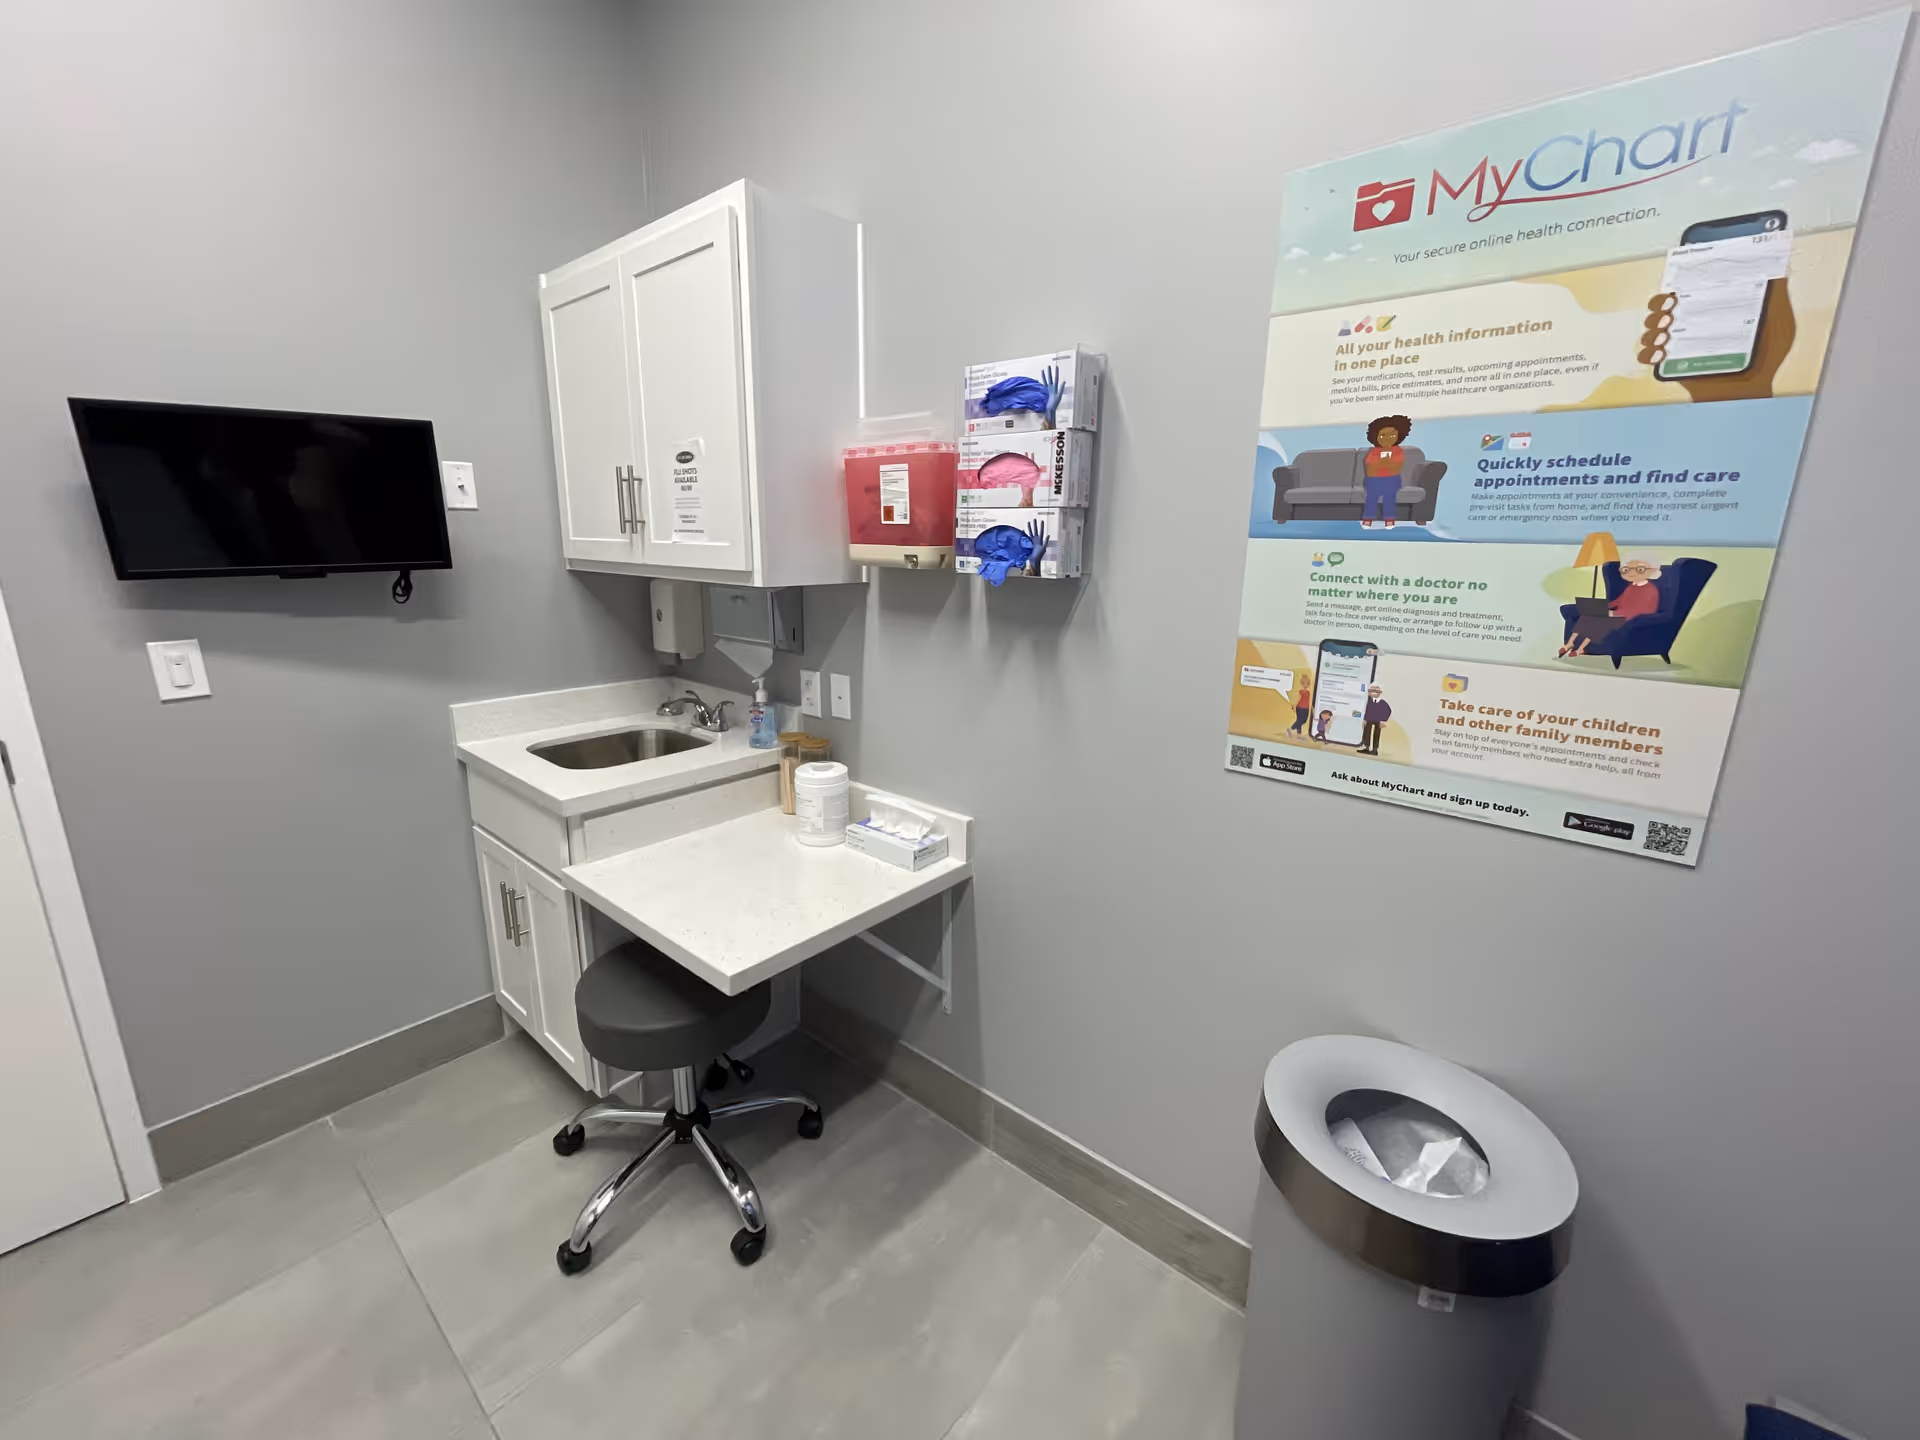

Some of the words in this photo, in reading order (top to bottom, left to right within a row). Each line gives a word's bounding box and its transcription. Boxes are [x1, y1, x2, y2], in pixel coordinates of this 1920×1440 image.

[1427, 99, 1748, 223] MyChart
[1393, 250, 1421, 264] Your
[1424, 244, 1466, 258] secure
[1469, 233, 1513, 251] online
[1516, 222, 1563, 241] health
[1566, 206, 1660, 232] connection.
[1336, 343, 1354, 355] All
[1357, 341, 1391, 355] your
[1394, 332, 1444, 349] health
[1448, 320, 1553, 342] information
[1334, 360, 1347, 371] in
[1351, 359, 1376, 369] one
[1380, 354, 1420, 369] place
[1346, 376, 1363, 384] your
[1365, 371, 1416, 381] medications,
[1418, 369, 1433, 377] test
[1434, 366, 1465, 375] results,
[1468, 361, 1512, 373] upcoming
[1515, 353, 1586, 368] appointments,
[1331, 385, 1360, 395] medical
[1361, 384, 1379, 392] bills,
[1381, 382, 1400, 391] price
[1402, 379, 1443, 389] estimates,
[1446, 376, 1463, 384] and
[1464, 375, 1487, 383] more
[1490, 372, 1501, 380] all
[1503, 371, 1511, 379] in
[1533, 368, 1562, 378] place,
[1565, 365, 1589, 374] even
[1592, 362, 1600, 371] if
[1330, 395, 1354, 406] you've
[1405, 389, 1439, 400] multiple
[1441, 386, 1487, 395] healthcare
[1489, 380, 1554, 392] organizations.
[1477, 457, 1542, 472] Quickly
[1546, 453, 1632, 468] schedule
[1474, 474, 1599, 489] appointments
[1604, 471, 1641, 484] and
[1646, 469, 1689, 483] find
[1693, 471, 1741, 482] care
[1469, 503, 1505, 511] pre-visit
[1558, 502, 1588, 511] home,
[1590, 502, 1610, 510] and
[1613, 502, 1633, 510] find
[1636, 502, 1653, 510] the
[1656, 502, 1698, 510] nearest
[1701, 501, 1739, 511] urgent
[1496, 492, 1561, 502] appointments
[1575, 492, 1598, 500] your
[1600, 490, 1671, 499] convenience,
[1673, 489, 1727, 499] complete
[1499, 514, 1550, 523] emergency
[1611, 514, 1629, 522] you
[1632, 513, 1659, 521] need
[1662, 513, 1672, 521] it.
[1310, 572, 1364, 584] Connect
[1367, 574, 1399, 586] with
[1402, 578, 1411, 587] a
[1414, 576, 1465, 590] doctor
[1467, 581, 1488, 591] no
[1308, 588, 1353, 598] matter
[1356, 589, 1399, 601] where
[1402, 593, 1429, 604] you
[1433, 595, 1458, 605] are
[1319, 610, 1360, 619] face-to-face
[1378, 615, 1401, 623] video,
[1413, 619, 1443, 627] arrange
[1455, 620, 1481, 629] follow
[1496, 624, 1515, 632] with
[1331, 603, 1363, 612] message,
[1378, 606, 1402, 614] online
[1402, 607, 1440, 617] diagnosis
[1442, 610, 1457, 618] and
[1459, 611, 1504, 621] treatment,
[1336, 621, 1362, 629] person,
[1364, 623, 1403, 633] depending
[1417, 627, 1429, 635] the
[1431, 629, 1450, 637] level
[1481, 633, 1497, 641] you
[1440, 699, 1474, 712] Take
[1479, 705, 1512, 718] care
[1516, 709, 1535, 721] of
[1537, 713, 1579, 726] your
[1582, 718, 1660, 738] children
[1437, 715, 1465, 727] and
[1469, 720, 1512, 733] other
[1516, 724, 1570, 743] family
[1574, 735, 1664, 755] members
[1431, 746, 1448, 754] your
[1450, 750, 1485, 761] account.
[1434, 728, 1451, 737] Stay
[1465, 733, 1479, 742] top
[1491, 738, 1538, 750] everyone's
[1540, 744, 1606, 760] appointments
[1608, 755, 1628, 764] and
[1630, 758, 1660, 768] check
[1273, 761, 1285, 769] App
[1286, 764, 1302, 772] Store
[1454, 740, 1479, 751] family
[1480, 746, 1521, 757] members
[1523, 752, 1542, 760] who
[1544, 756, 1567, 765] need
[1569, 759, 1592, 769] extra
[1595, 763, 1619, 773] help,
[1621, 768, 1634, 776] all
[1636, 769, 1661, 779] from
[1331, 771, 1348, 781] Ask
[1350, 776, 1379, 787] about
[1381, 780, 1425, 796] MyChart
[1427, 791, 1447, 800] and
[1450, 795, 1472, 805] sign
[1475, 800, 1490, 809] up
[1493, 803, 1529, 817] today.
